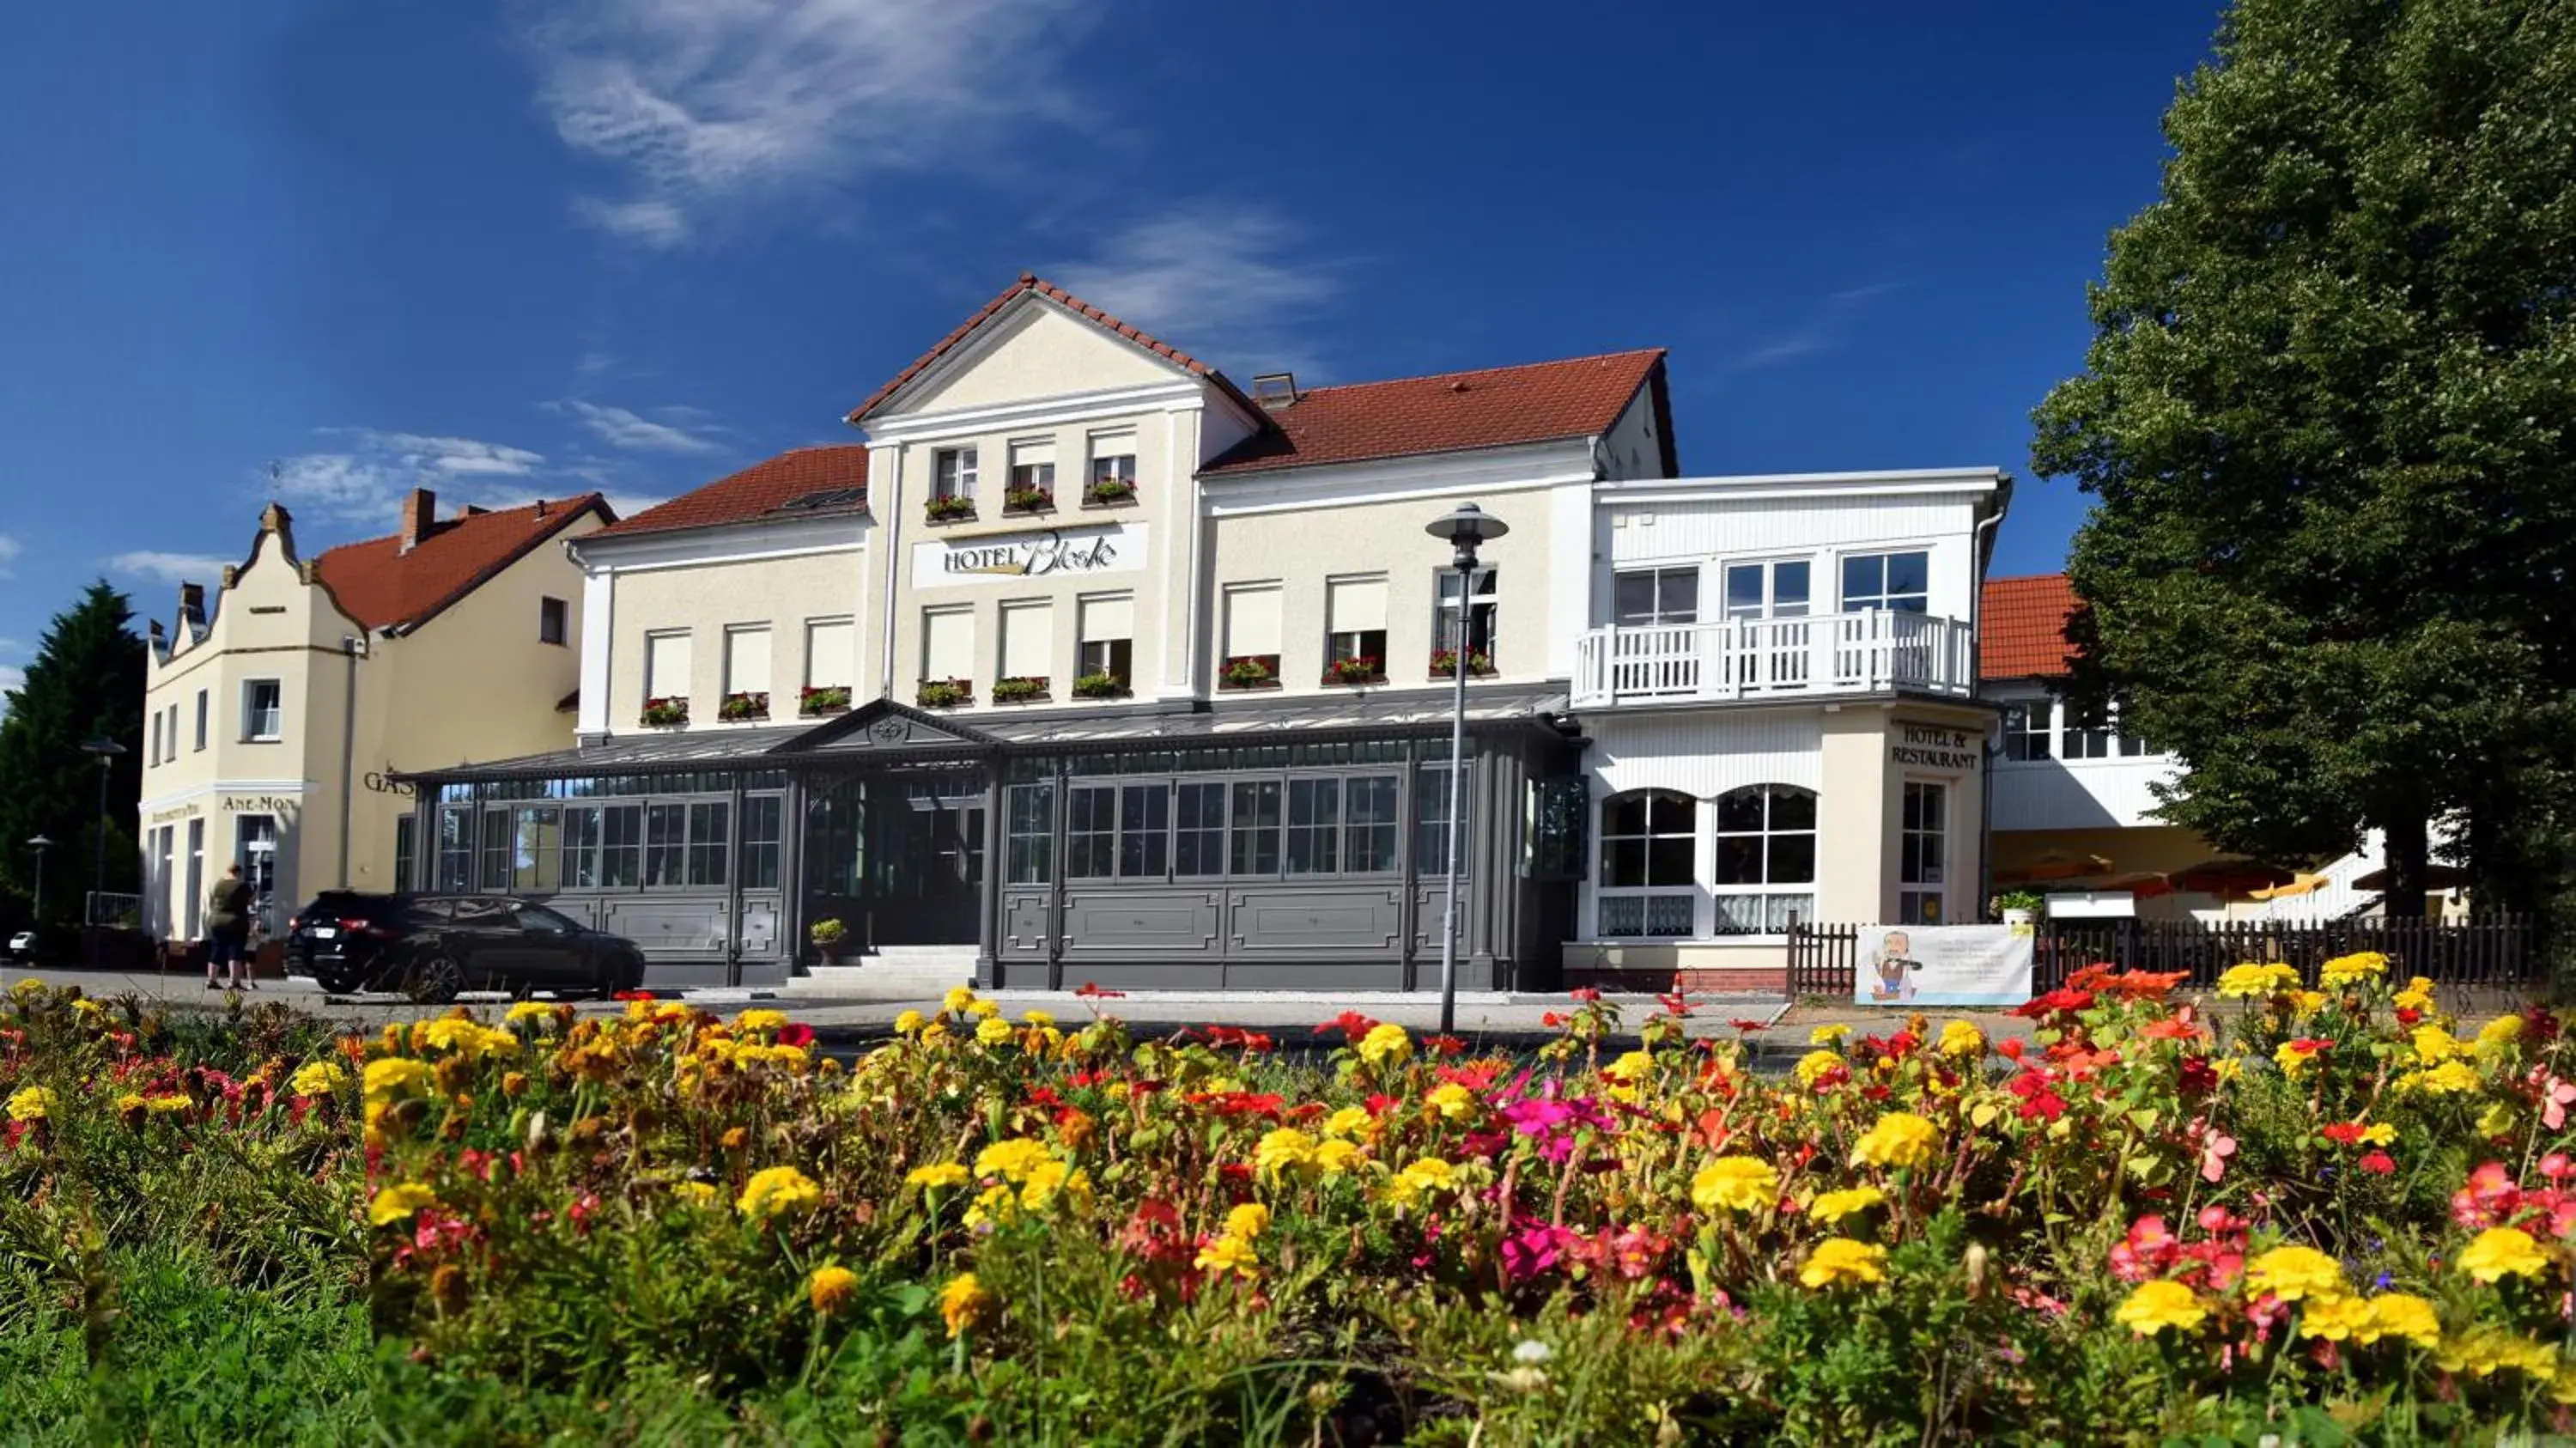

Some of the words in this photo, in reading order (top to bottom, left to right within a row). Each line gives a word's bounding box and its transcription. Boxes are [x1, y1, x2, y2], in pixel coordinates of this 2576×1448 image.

[945, 547, 1019, 572] HOTEL
[1904, 727, 1951, 746] HOTEL
[1953, 733, 1968, 748] &
[1892, 745, 1978, 770] RESTAURANT
